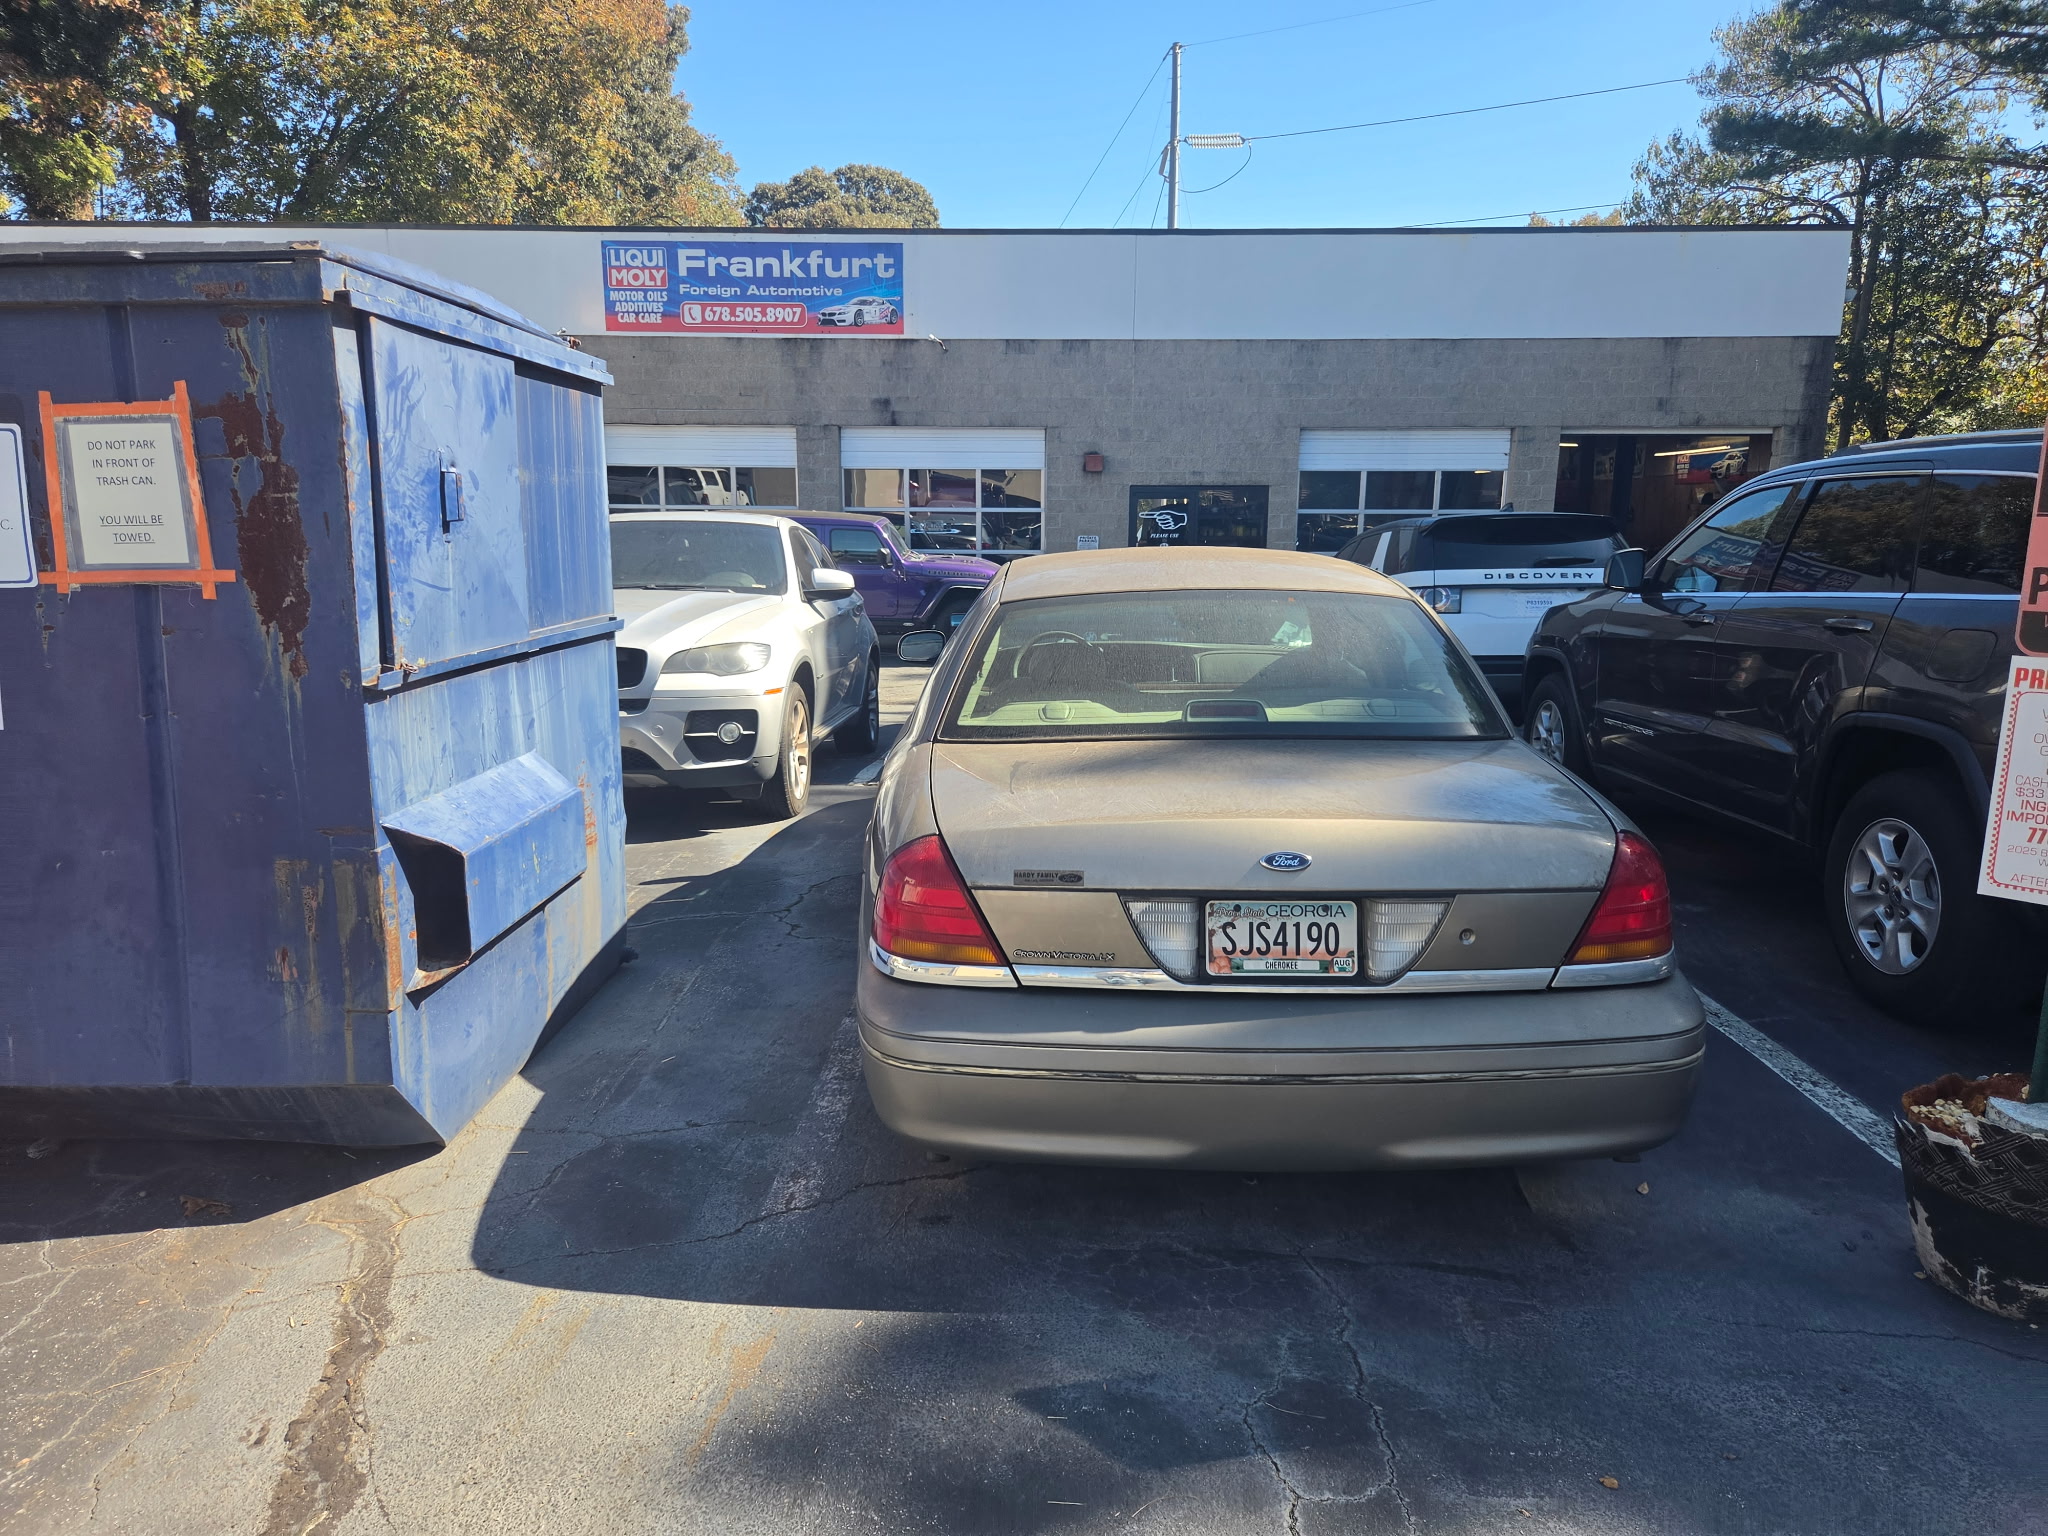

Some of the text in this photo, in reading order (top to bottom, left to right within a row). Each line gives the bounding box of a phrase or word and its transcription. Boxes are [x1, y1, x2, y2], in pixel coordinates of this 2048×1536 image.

[610, 249, 663, 267] LIQUI
[677, 249, 895, 278] Frankfurt
[611, 268, 666, 286] MOLY
[610, 291, 668, 301] MOTOR OILS
[679, 284, 842, 297] Foreign Automotive
[615, 302, 664, 312] ADDITIVES
[617, 313, 662, 323] CAR CARE
[704, 307, 802, 323] 678.505.8907
[87, 440, 156, 450] DO NOT PARK
[92, 458, 156, 468] IN FRONT OF
[96, 476, 157, 486] TRASH CAN.
[99, 514, 164, 525] YOU WILL BE
[113, 532, 155, 542] TOWED.
[1484, 572, 1594, 580] DISCOVERY
[2016, 774, 2048, 788] CASH
[2021, 800, 2048, 812] ING
[2006, 810, 2048, 825] IMPO
[2007, 844, 2038, 856] 2025
[1272, 854, 1301, 866] Ford
[1014, 871, 1059, 879] HARDY FAMILY
[1266, 904, 1347, 918] GEORGIA
[1221, 921, 1340, 957] SJS4190
[1099, 952, 1115, 962] LX
[1265, 961, 1298, 969] CHEROKEE
[1334, 959, 1351, 967] AUG
